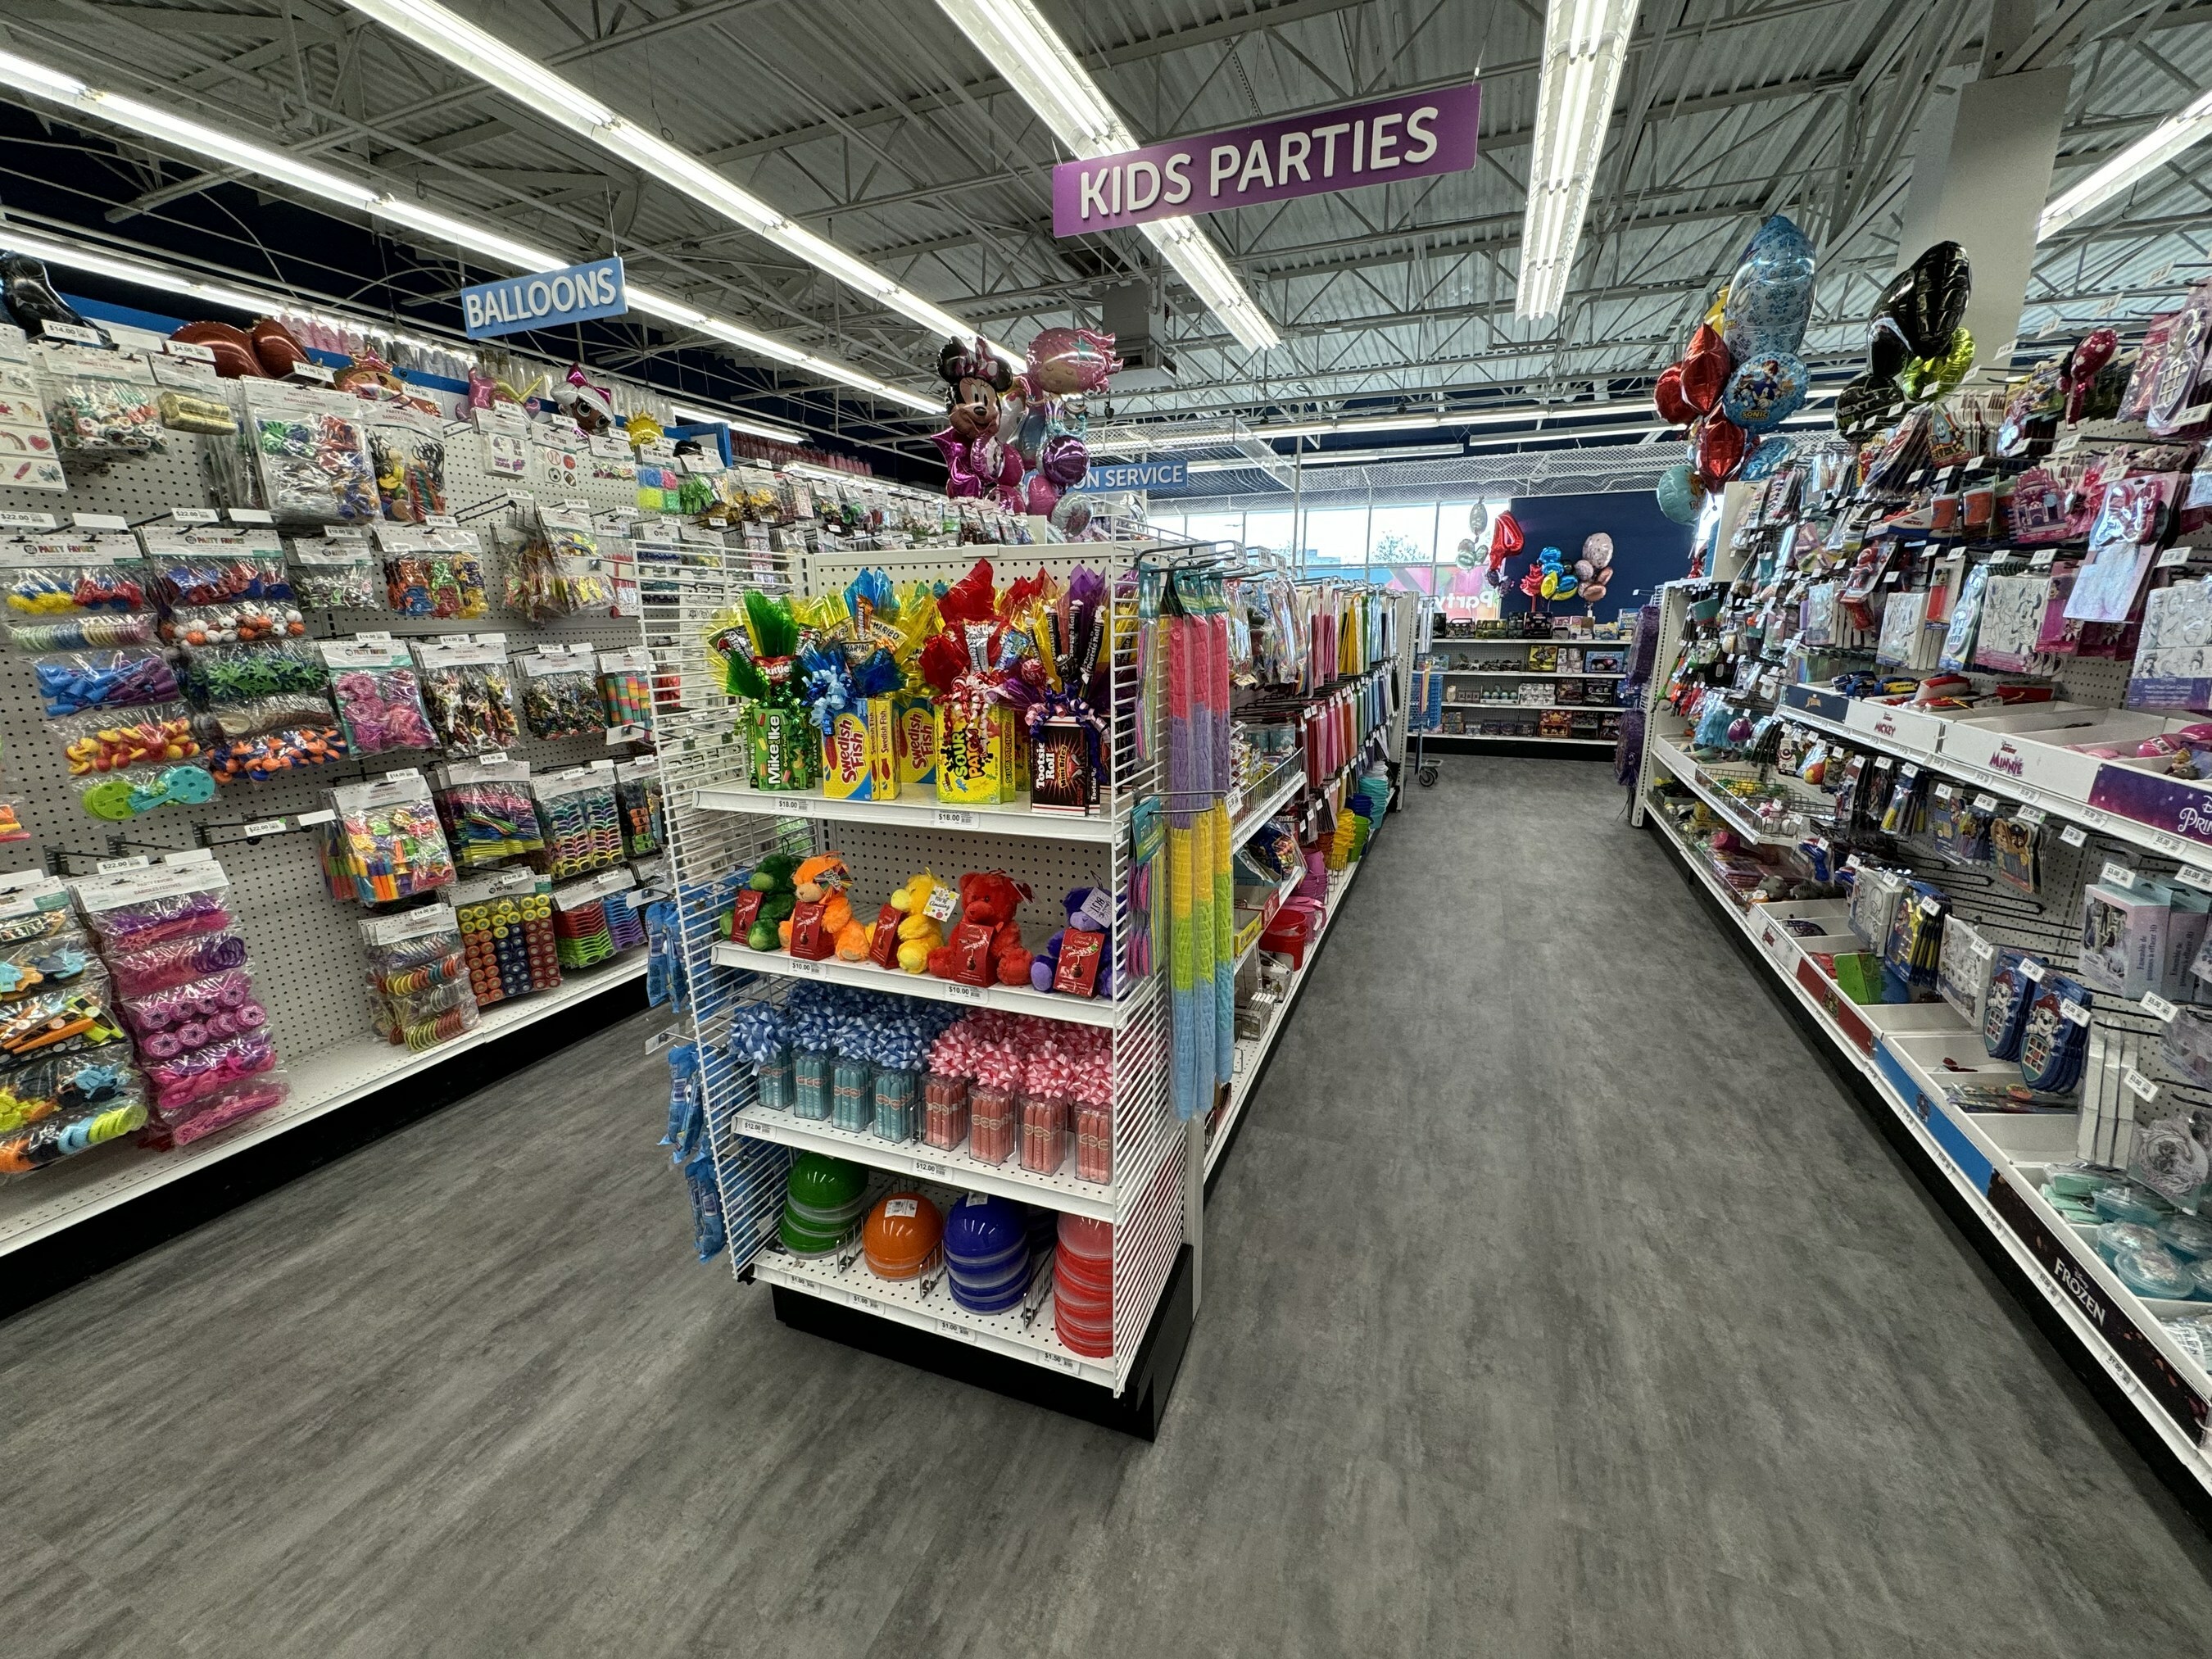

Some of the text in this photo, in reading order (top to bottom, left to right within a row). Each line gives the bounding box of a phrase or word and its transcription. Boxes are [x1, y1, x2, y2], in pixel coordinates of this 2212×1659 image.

[1080, 106, 1439, 220] KIDS PARTIES
[465, 266, 617, 329] BALLOONS
[49, 324, 76, 336] $14.00
[1838, 400, 1872, 417] NEXT
[1104, 465, 1184, 487] SERVICE
[1, 514, 29, 522] $22.00
[39, 545, 96, 553] PARTY FAVORS
[873, 621, 900, 641] HARIBO
[845, 644, 869, 653] HARIBO
[1086, 642, 1095, 670] Tootsie
[761, 664, 792, 676] kittle
[768, 715, 781, 741] Ike
[881, 724, 889, 753] Swedish
[908, 712, 934, 770] Swedish Fish
[837, 718, 866, 784] Swedish Fish
[951, 730, 968, 778] SOUR
[768, 745, 782, 785] Mike
[1036, 741, 1055, 790] Tootsie Roll
[1988, 752, 2024, 777] MINNIE
[779, 800, 798, 809] $18.00
[938, 813, 960, 822] $18.00
[249, 824, 269, 832] $22.00
[2156, 836, 2170, 846] $5.00
[102, 861, 127, 870] $22.00
[2183, 868, 2201, 879] $5.00
[929, 900, 950, 911] Amazing
[1090, 895, 1105, 913] BEST
[792, 962, 810, 971] $10.00
[949, 986, 969, 995] $10.00
[2147, 996, 2162, 1009] $5.00
[745, 1122, 762, 1131] $12.00
[916, 1162, 936, 1172] $12.00
[791, 1276, 805, 1285] $1.00
[2054, 1257, 2105, 1327] FROZEN
[854, 1295, 868, 1304] $1.00
[942, 1321, 958, 1331] $1.00
[1045, 1352, 1061, 1362] $1.50
